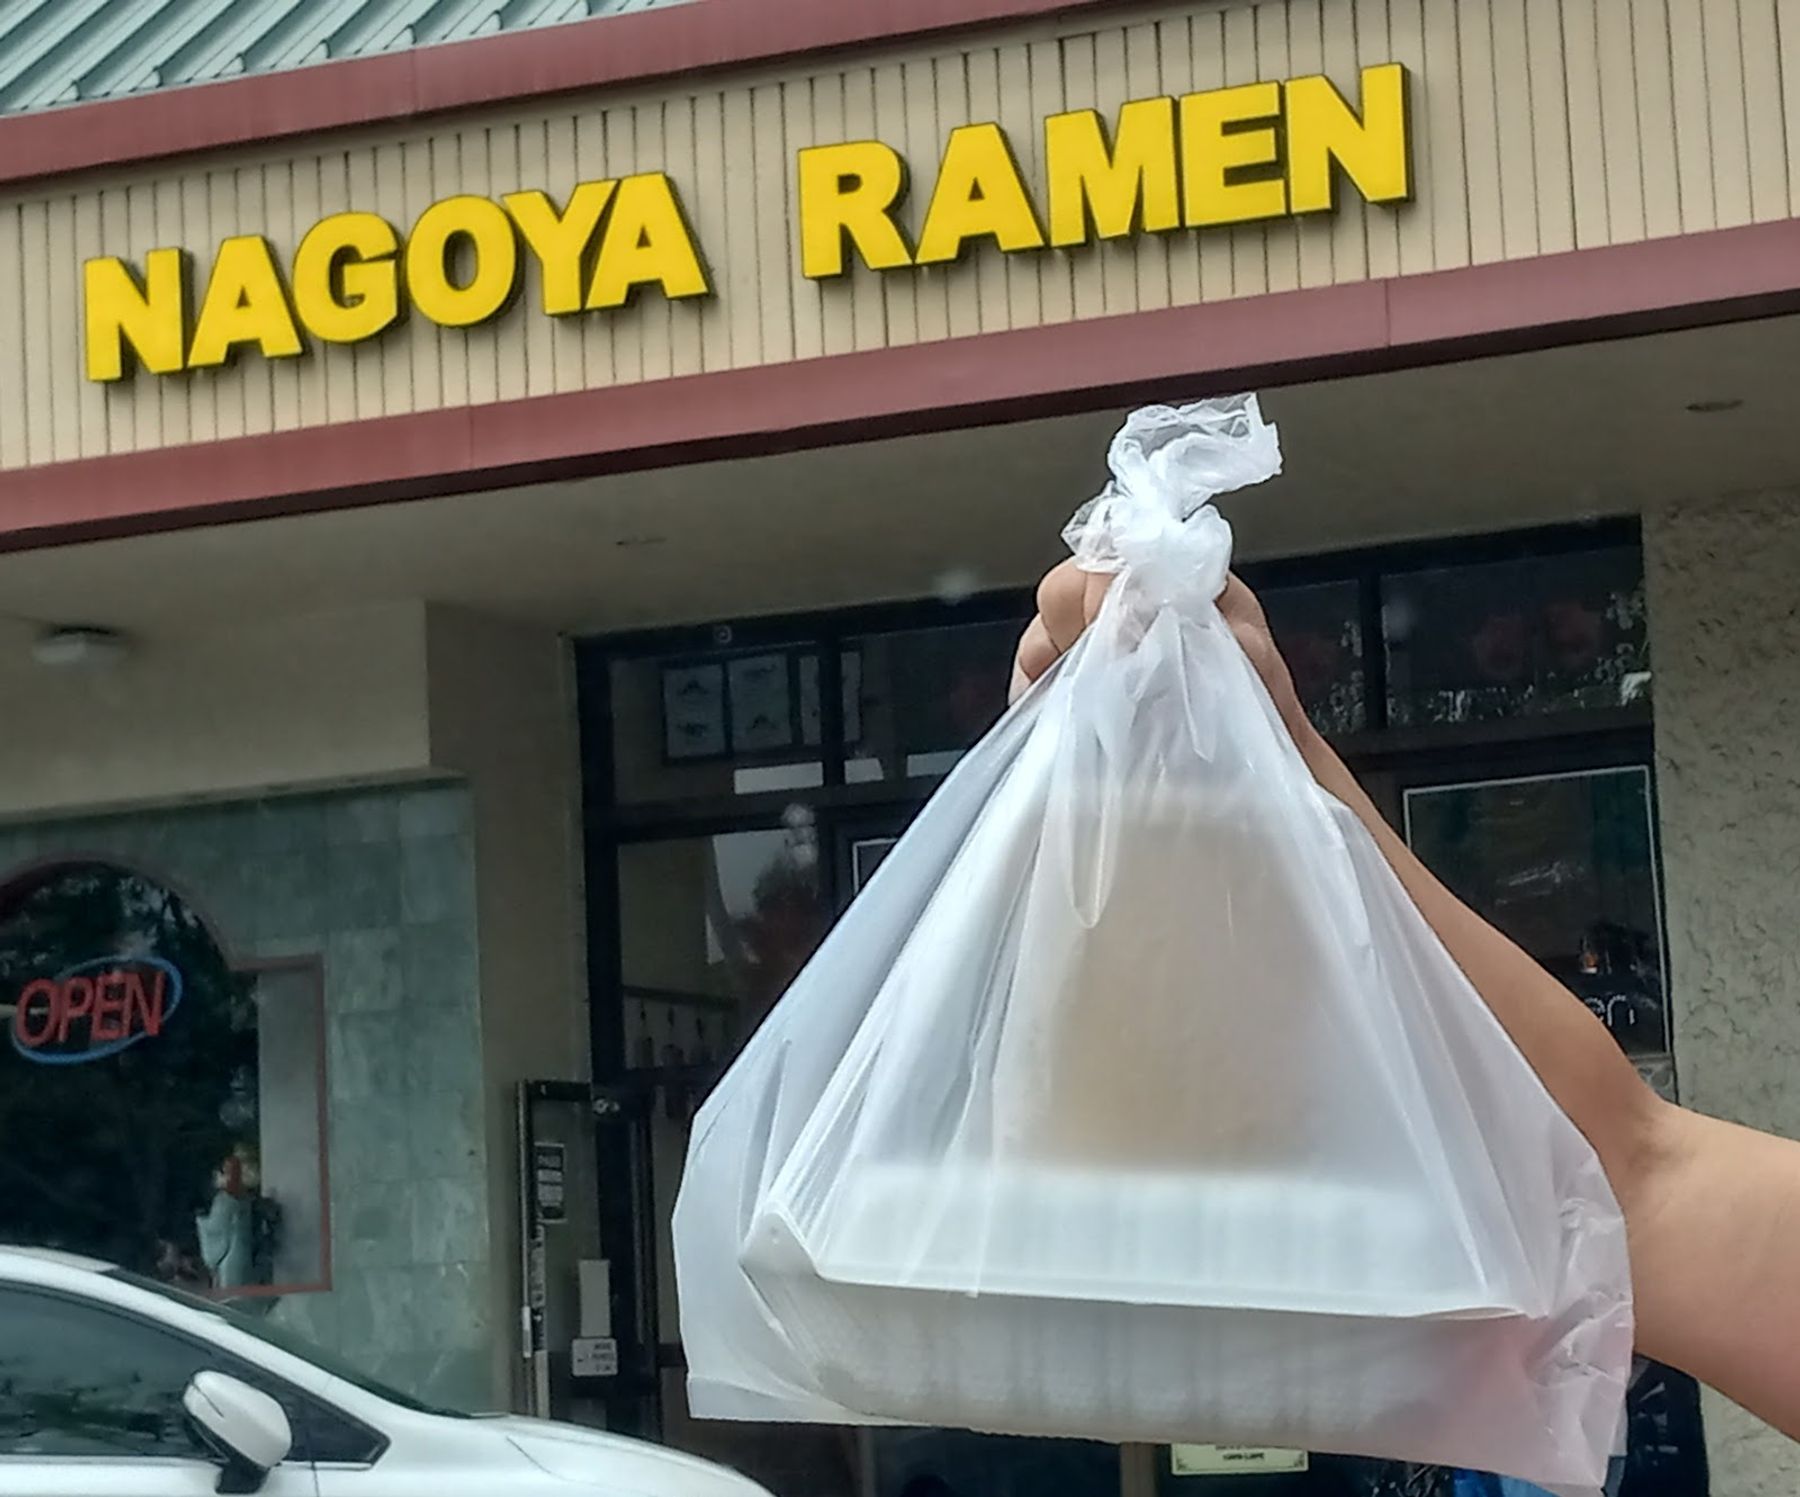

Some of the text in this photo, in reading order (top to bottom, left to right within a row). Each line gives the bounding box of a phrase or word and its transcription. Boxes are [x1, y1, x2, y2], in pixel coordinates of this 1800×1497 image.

[84, 63, 1409, 382] NAGOYA RAMEN
[16, 970, 166, 1047] OPEN
